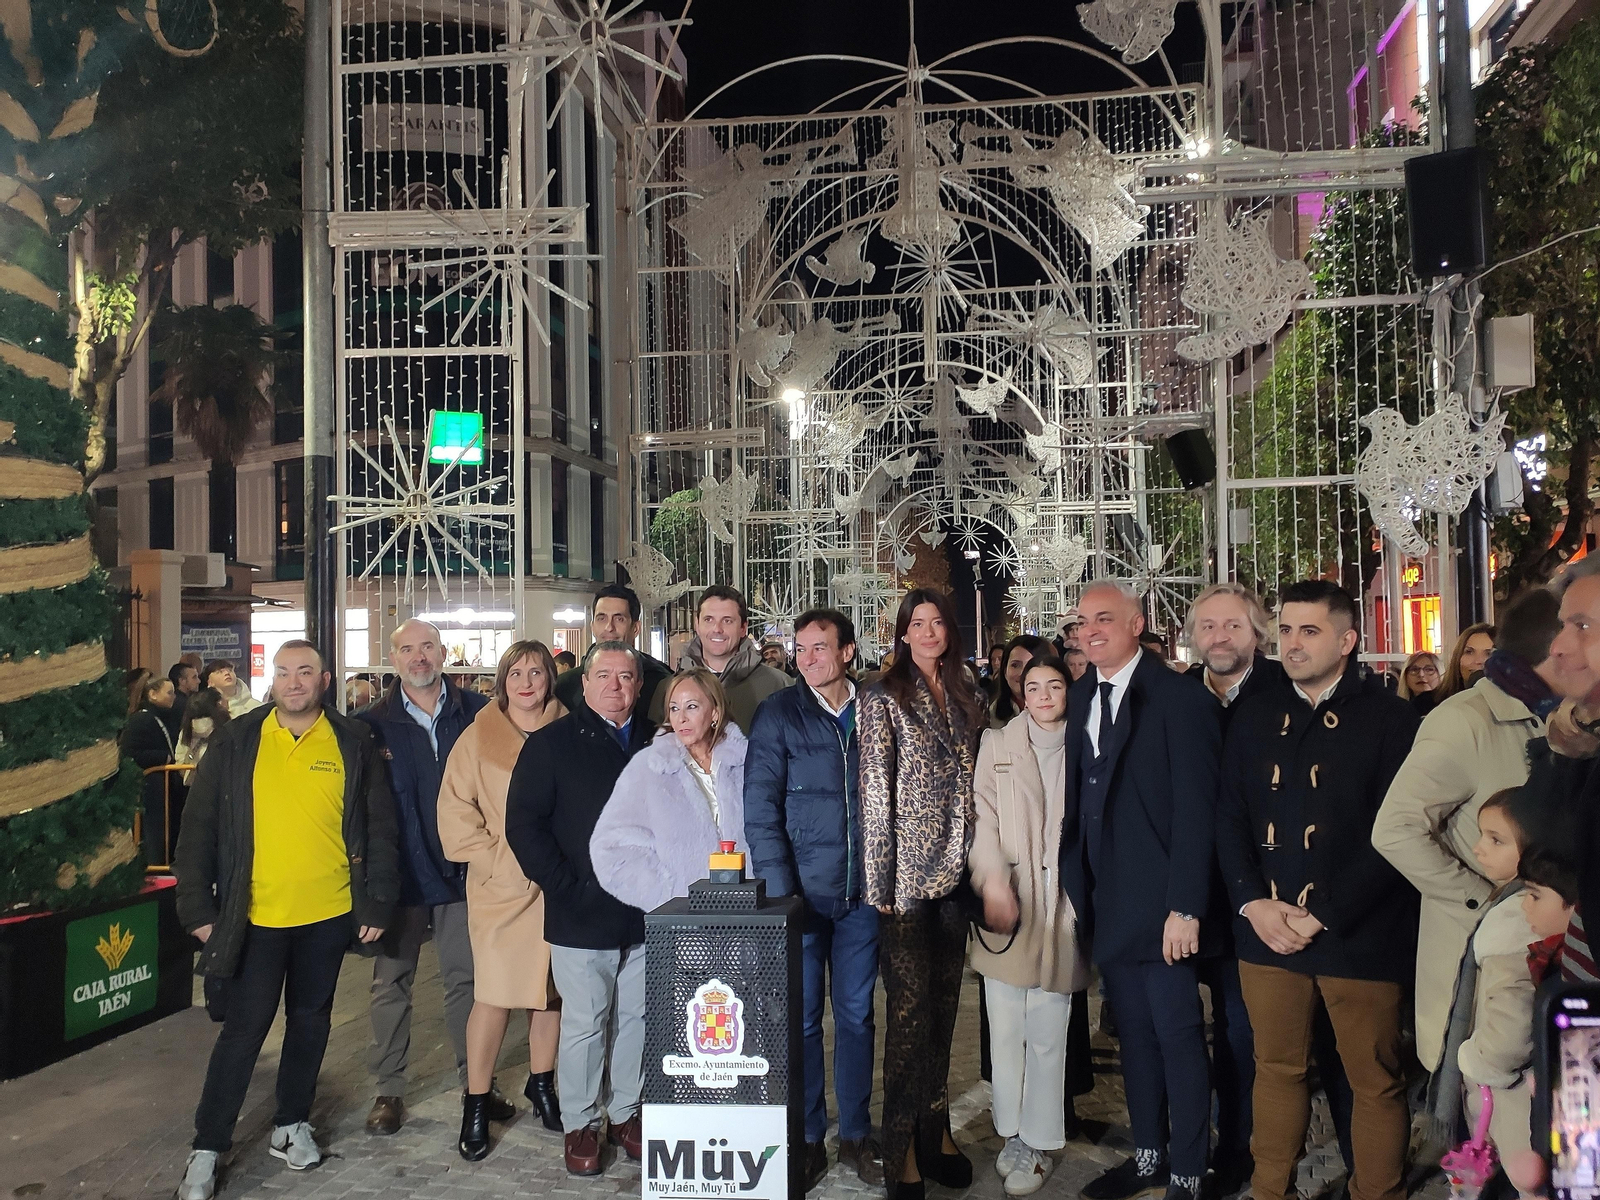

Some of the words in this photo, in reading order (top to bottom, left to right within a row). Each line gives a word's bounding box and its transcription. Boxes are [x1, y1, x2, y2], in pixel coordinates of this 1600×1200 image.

[391, 116, 480, 133] GARANTIS
[310, 765, 332, 773] Alfonso
[73, 979, 107, 1003] CAJA
[108, 964, 152, 992] RURAL
[98, 990, 132, 1019] JAÉN
[668, 1059, 701, 1069] Excmo.
[703, 1060, 764, 1070] Ayuntamiento
[699, 1072, 711, 1081] de
[712, 1072, 733, 1082] Jaén
[647, 1138, 772, 1191] Müy
[648, 1181, 670, 1195] Muy
[671, 1181, 699, 1197] Jaén,
[701, 1182, 723, 1196] Muy
[724, 1182, 737, 1194] Tú
